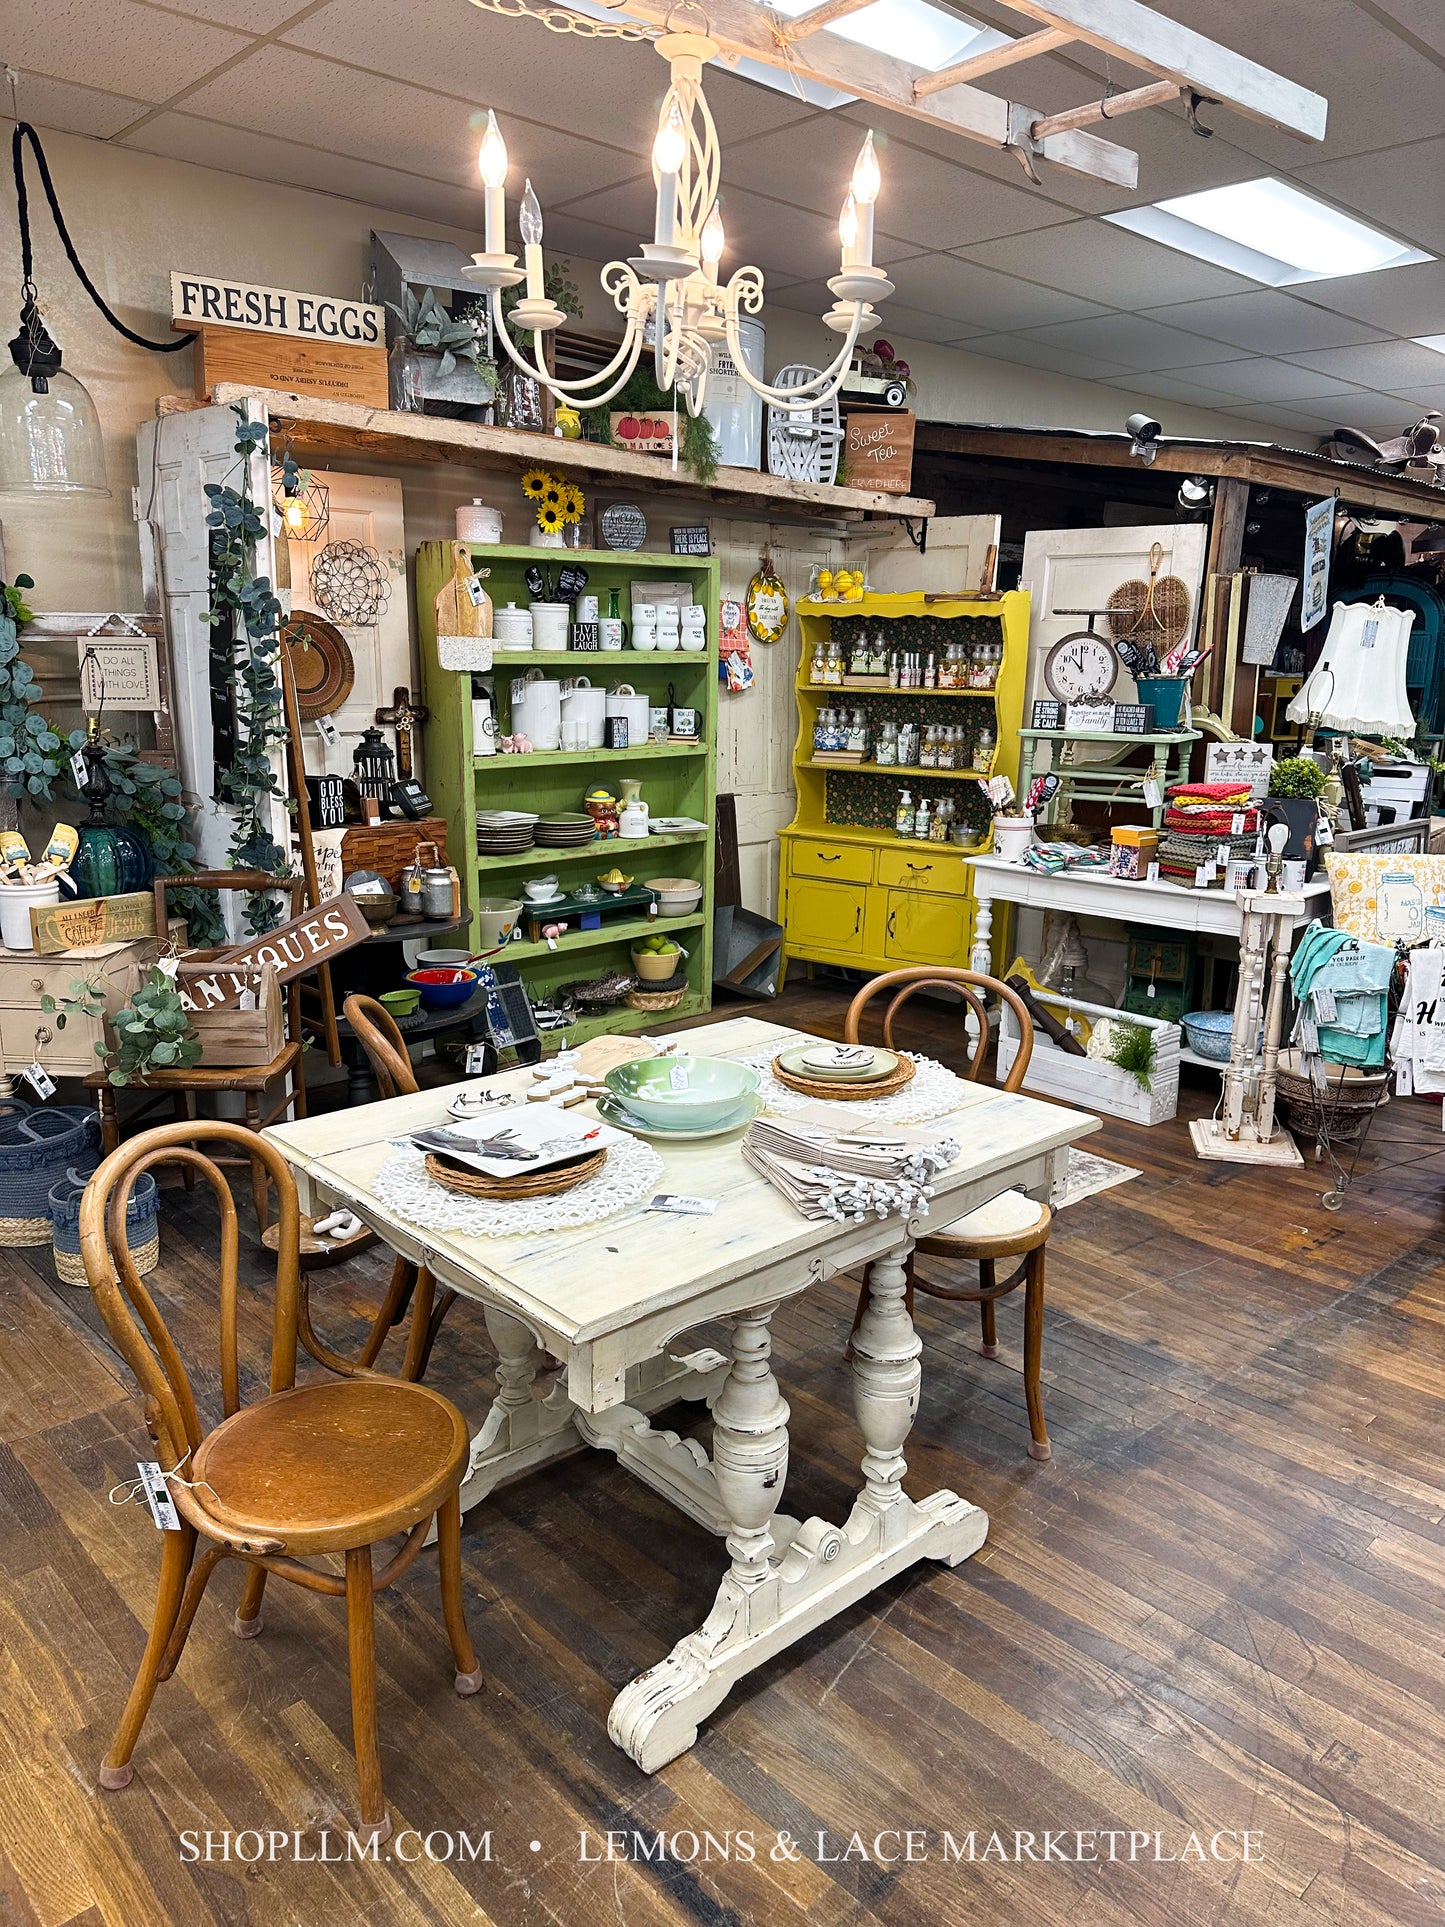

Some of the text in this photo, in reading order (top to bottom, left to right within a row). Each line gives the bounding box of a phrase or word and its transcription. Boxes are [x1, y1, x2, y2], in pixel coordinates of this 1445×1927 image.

[181, 281, 378, 342] FRESH EGGS
[319, 380, 348, 388] DREYFUS
[850, 422, 894, 450] Sweet
[616, 442, 673, 450] OMATOES
[867, 445, 898, 464] Tea
[846, 479, 907, 489] SERVED HERE
[674, 534, 708, 544] THERE IS PEACE
[675, 545, 680, 553] IN
[688, 544, 708, 553] KINGDOM
[574, 624, 598, 633] LIVE
[574, 633, 598, 642] LOVE
[573, 642, 598, 650] LAUGH
[1072, 648, 1078, 656] 11
[103, 656, 135, 664] DO ALL
[1099, 656, 1104, 664] 2
[122, 680, 145, 689] LOVE
[1034, 719, 1057, 728] BE CALM
[1068, 716, 1108, 728] Family
[320, 780, 343, 797] GOD
[321, 796, 344, 809] BLESS
[321, 807, 344, 825] YOU
[65, 922, 99, 942] COFFEE
[107, 917, 145, 938] JESUS
